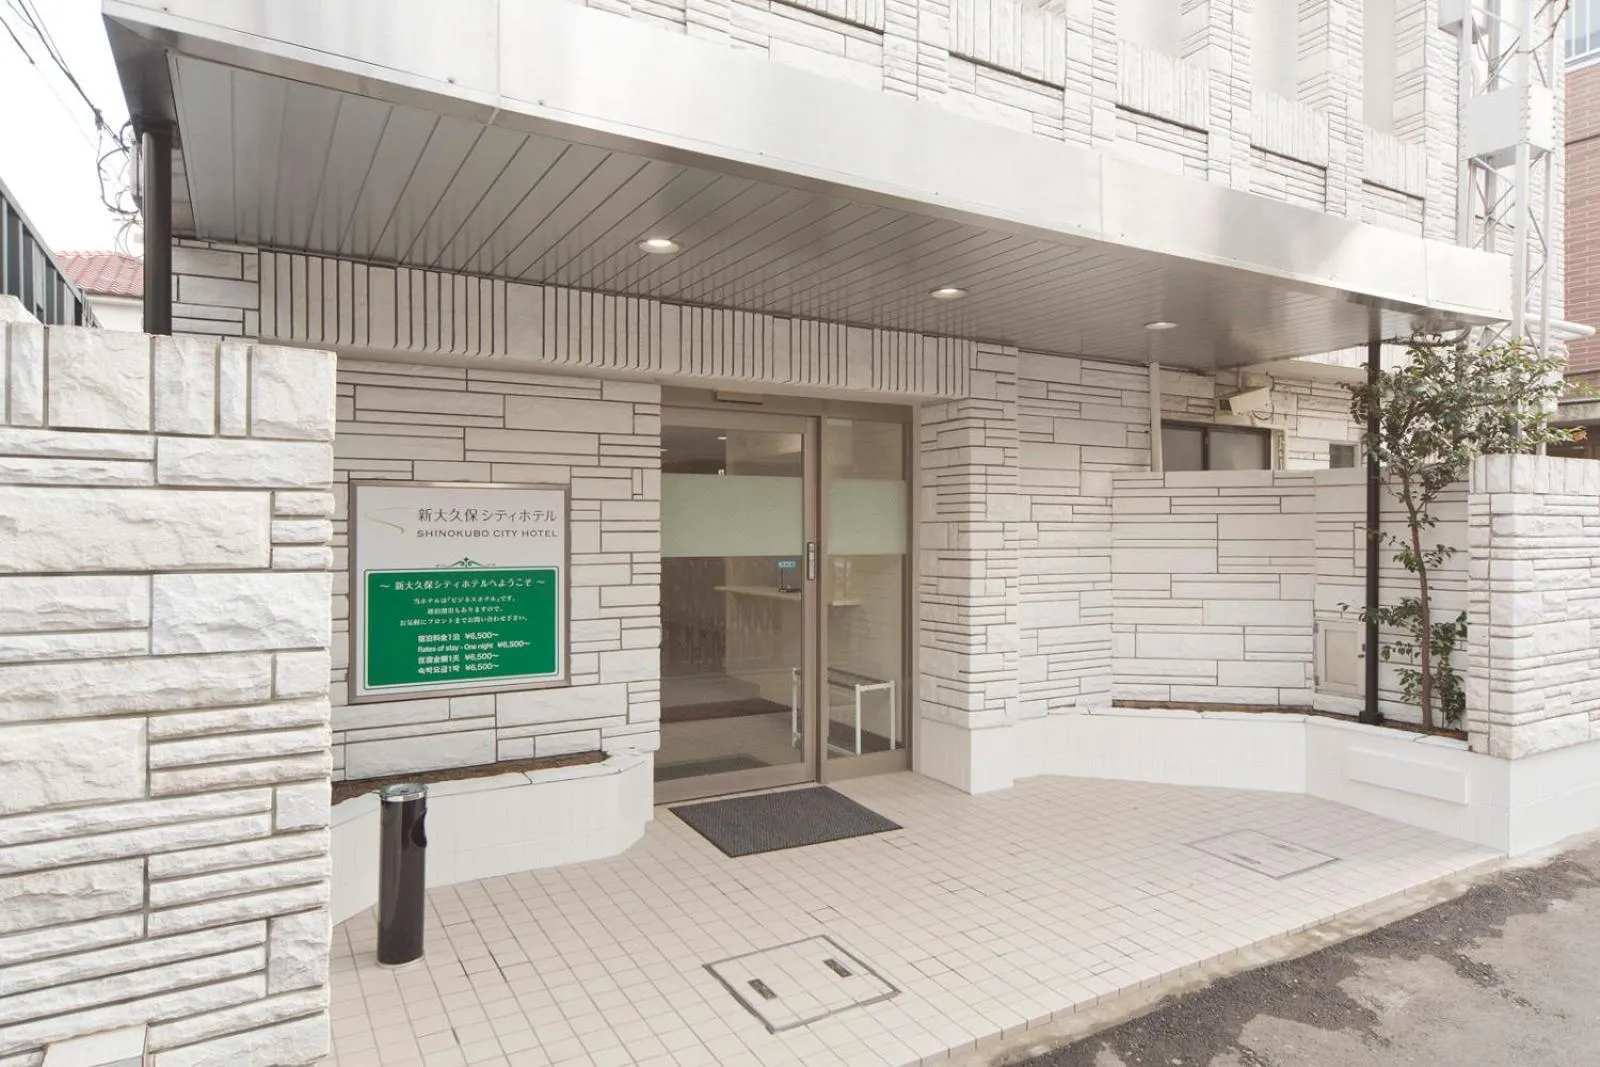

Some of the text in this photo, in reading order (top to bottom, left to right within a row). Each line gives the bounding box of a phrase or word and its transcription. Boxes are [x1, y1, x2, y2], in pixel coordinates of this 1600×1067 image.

[418, 508, 557, 523] 新大久保シティホテル
[416, 529, 559, 538] SHINOKUBO CITY HOTEL
[446, 645, 459, 653] stay
[477, 642, 494, 651] night
